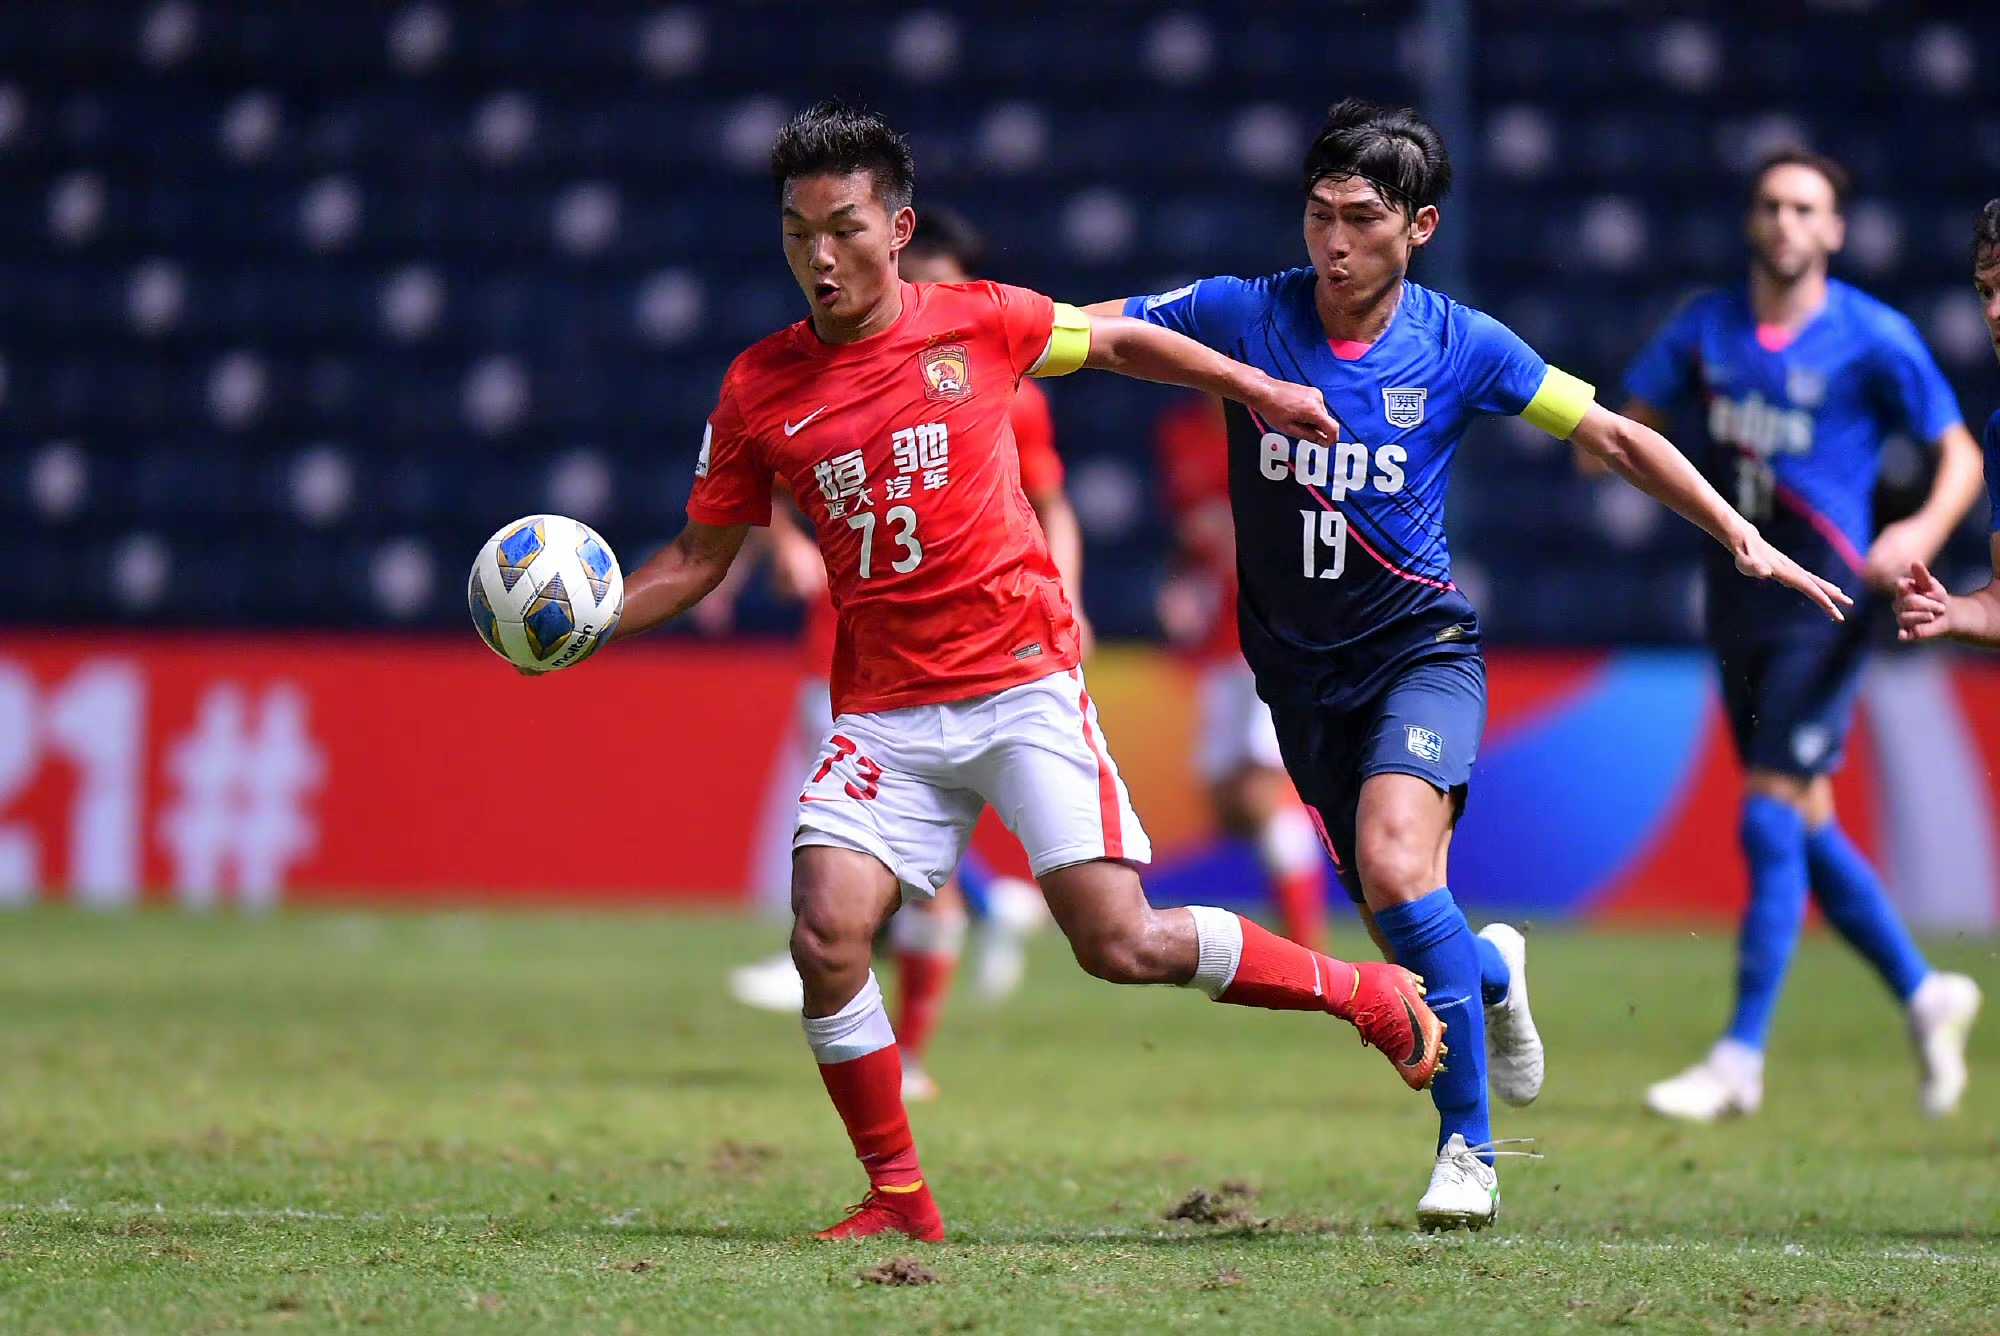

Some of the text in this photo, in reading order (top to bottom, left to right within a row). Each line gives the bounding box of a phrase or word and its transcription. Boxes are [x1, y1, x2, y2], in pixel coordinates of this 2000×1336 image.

[846, 505, 923, 579] 73
[1299, 509, 1348, 580] 19
[551, 623, 594, 668] molten
[811, 734, 882, 801] 73
